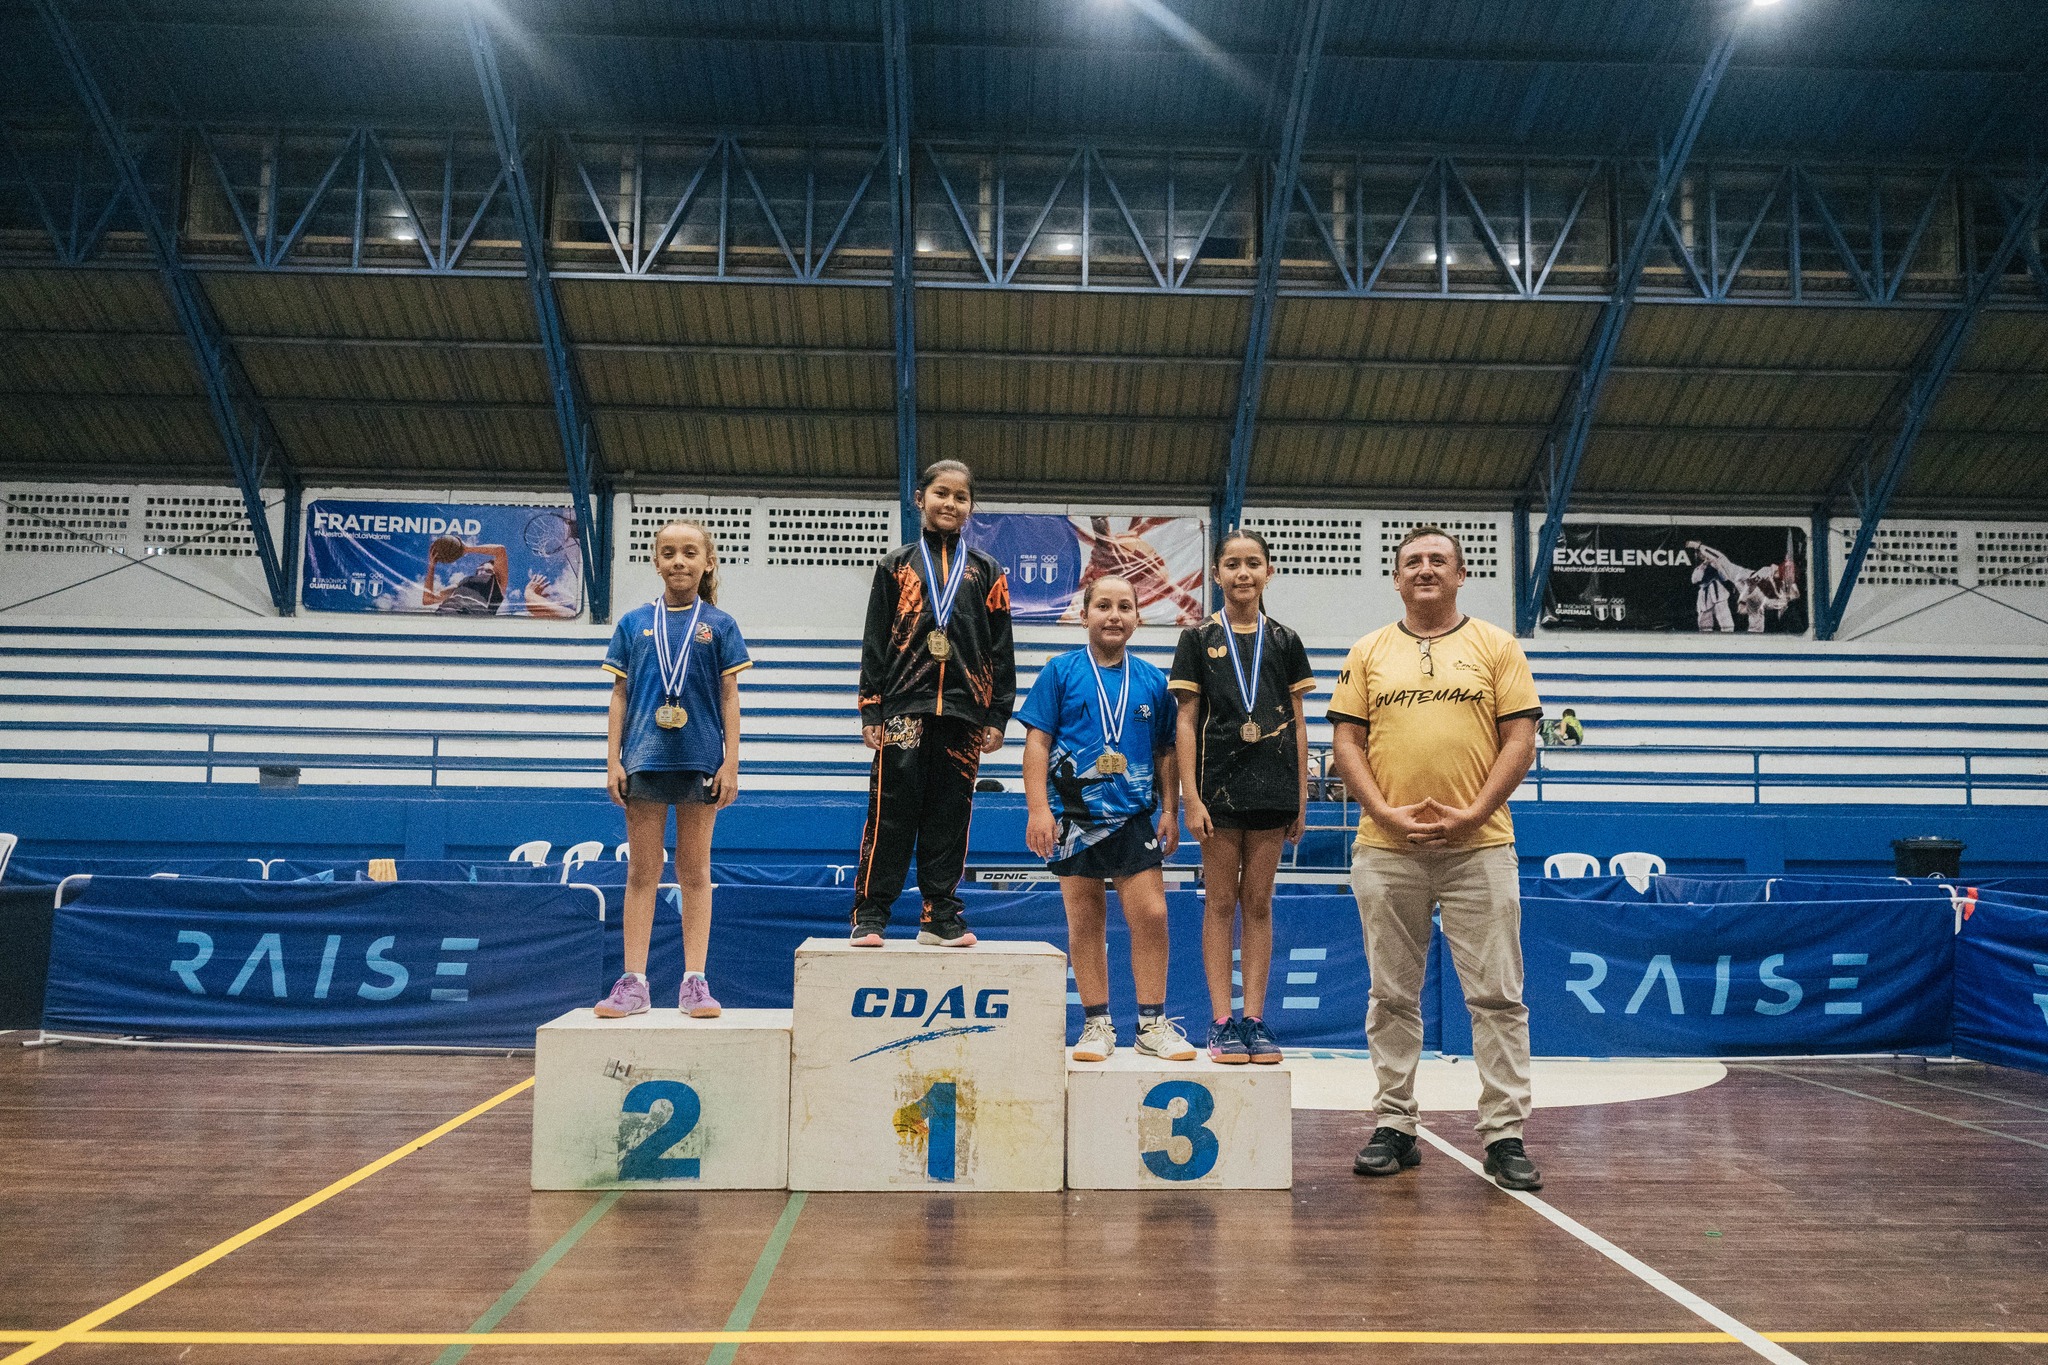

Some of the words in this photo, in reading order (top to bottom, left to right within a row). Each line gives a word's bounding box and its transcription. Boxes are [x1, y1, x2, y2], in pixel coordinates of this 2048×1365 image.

[314, 512, 482, 535] FRATERNIDAD
[1552, 549, 1692, 566] EXCELENCIA
[1555, 608, 1592, 616] GUATEMALA
[1376, 688, 1487, 708] GUATEMALA
[170, 930, 479, 1000] RAISE
[1566, 952, 1868, 1016] RAISE
[851, 985, 1009, 1027] CDAG
[618, 1080, 701, 1181] 2
[915, 1082, 956, 1182] 1
[1142, 1081, 1218, 1180] 3
